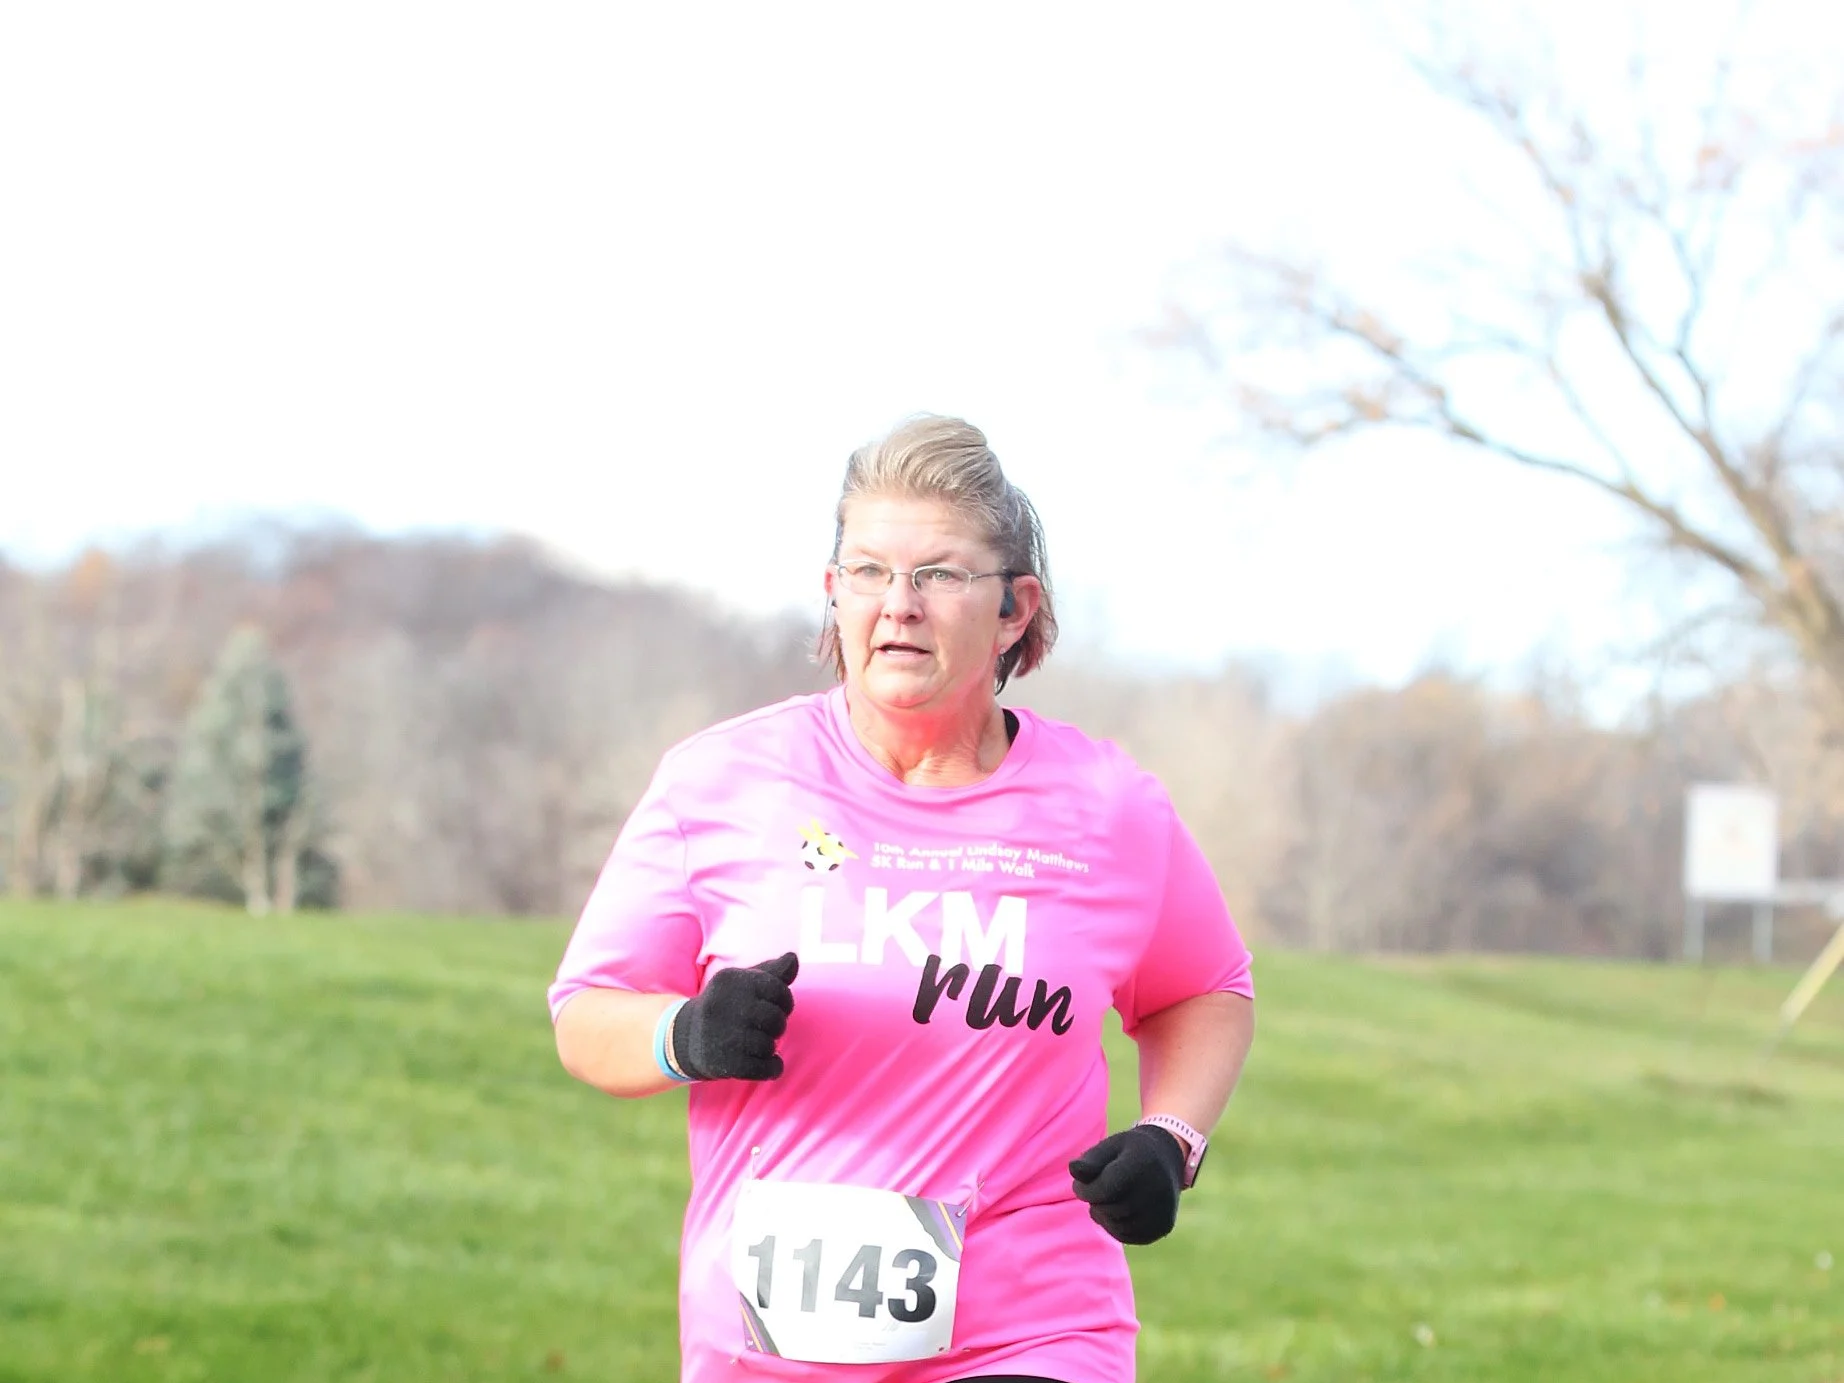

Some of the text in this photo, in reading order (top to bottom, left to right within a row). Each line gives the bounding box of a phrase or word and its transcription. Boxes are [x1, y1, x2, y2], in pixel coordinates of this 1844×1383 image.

[871, 854, 1036, 879] 5K Run & 1 Mile Walk
[908, 847, 963, 858] Annual
[967, 842, 1022, 862] Lindsay
[1027, 848, 1090, 874] Matthews
[798, 886, 1028, 975] LKM
[912, 953, 1075, 1036] run
[747, 1235, 938, 1324] 1143
